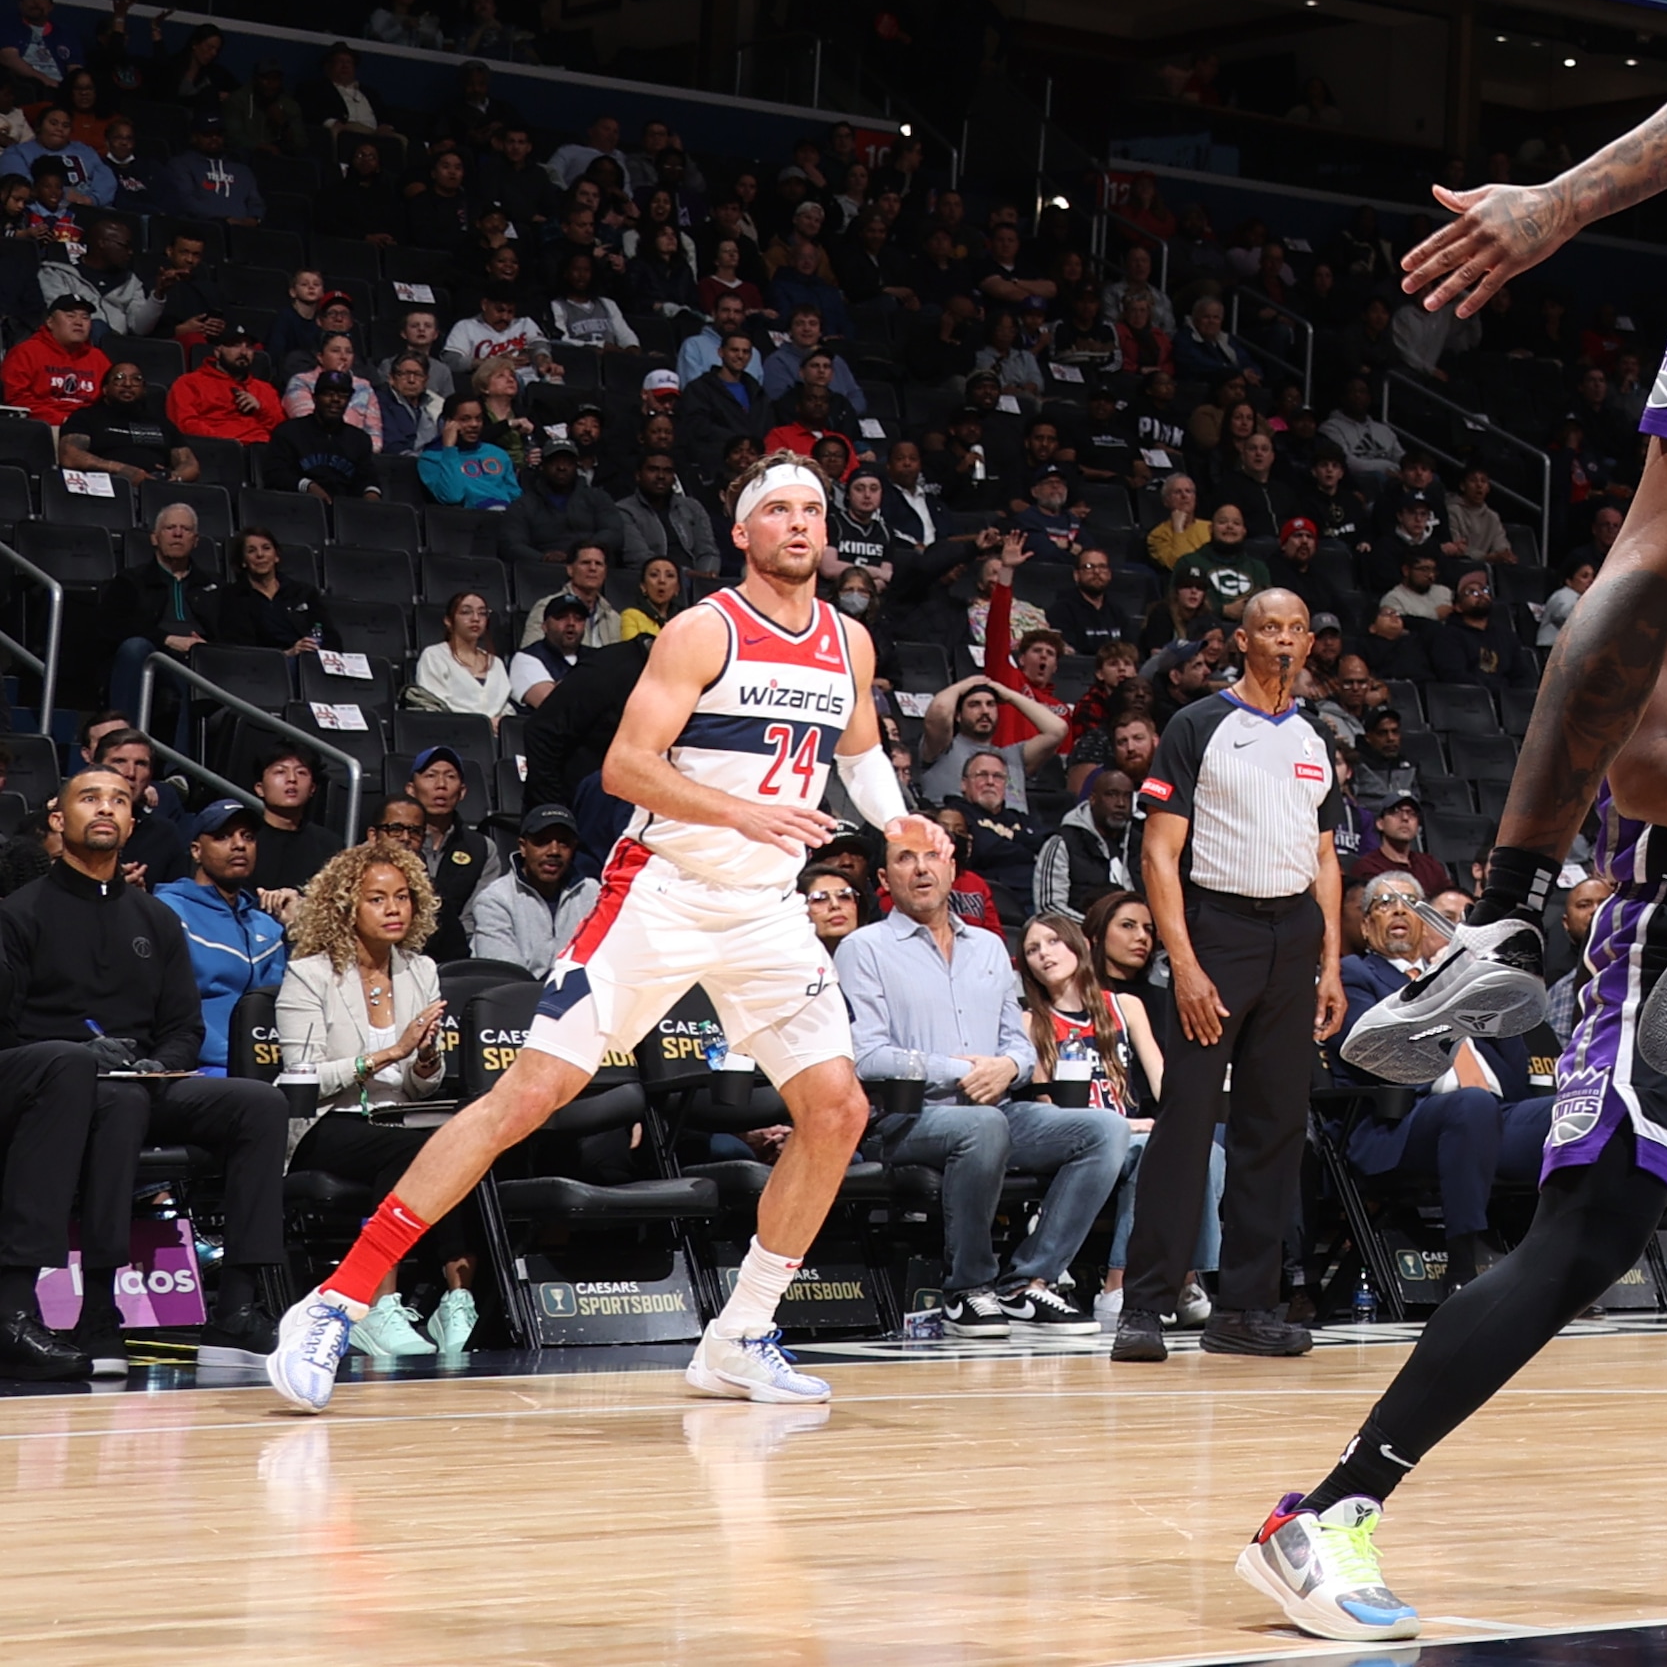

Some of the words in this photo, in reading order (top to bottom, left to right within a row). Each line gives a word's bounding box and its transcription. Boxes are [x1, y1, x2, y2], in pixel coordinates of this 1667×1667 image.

[1138, 415, 1186, 448] PINK
[838, 540, 885, 559] KINGS
[740, 679, 844, 717] wizards
[758, 726, 822, 798] 24
[480, 1028, 530, 1046] CAES
[577, 1281, 640, 1295] CAESARS
[784, 1279, 865, 1303] ORTSBOOK
[579, 1289, 687, 1316] SPORTSBOOK
